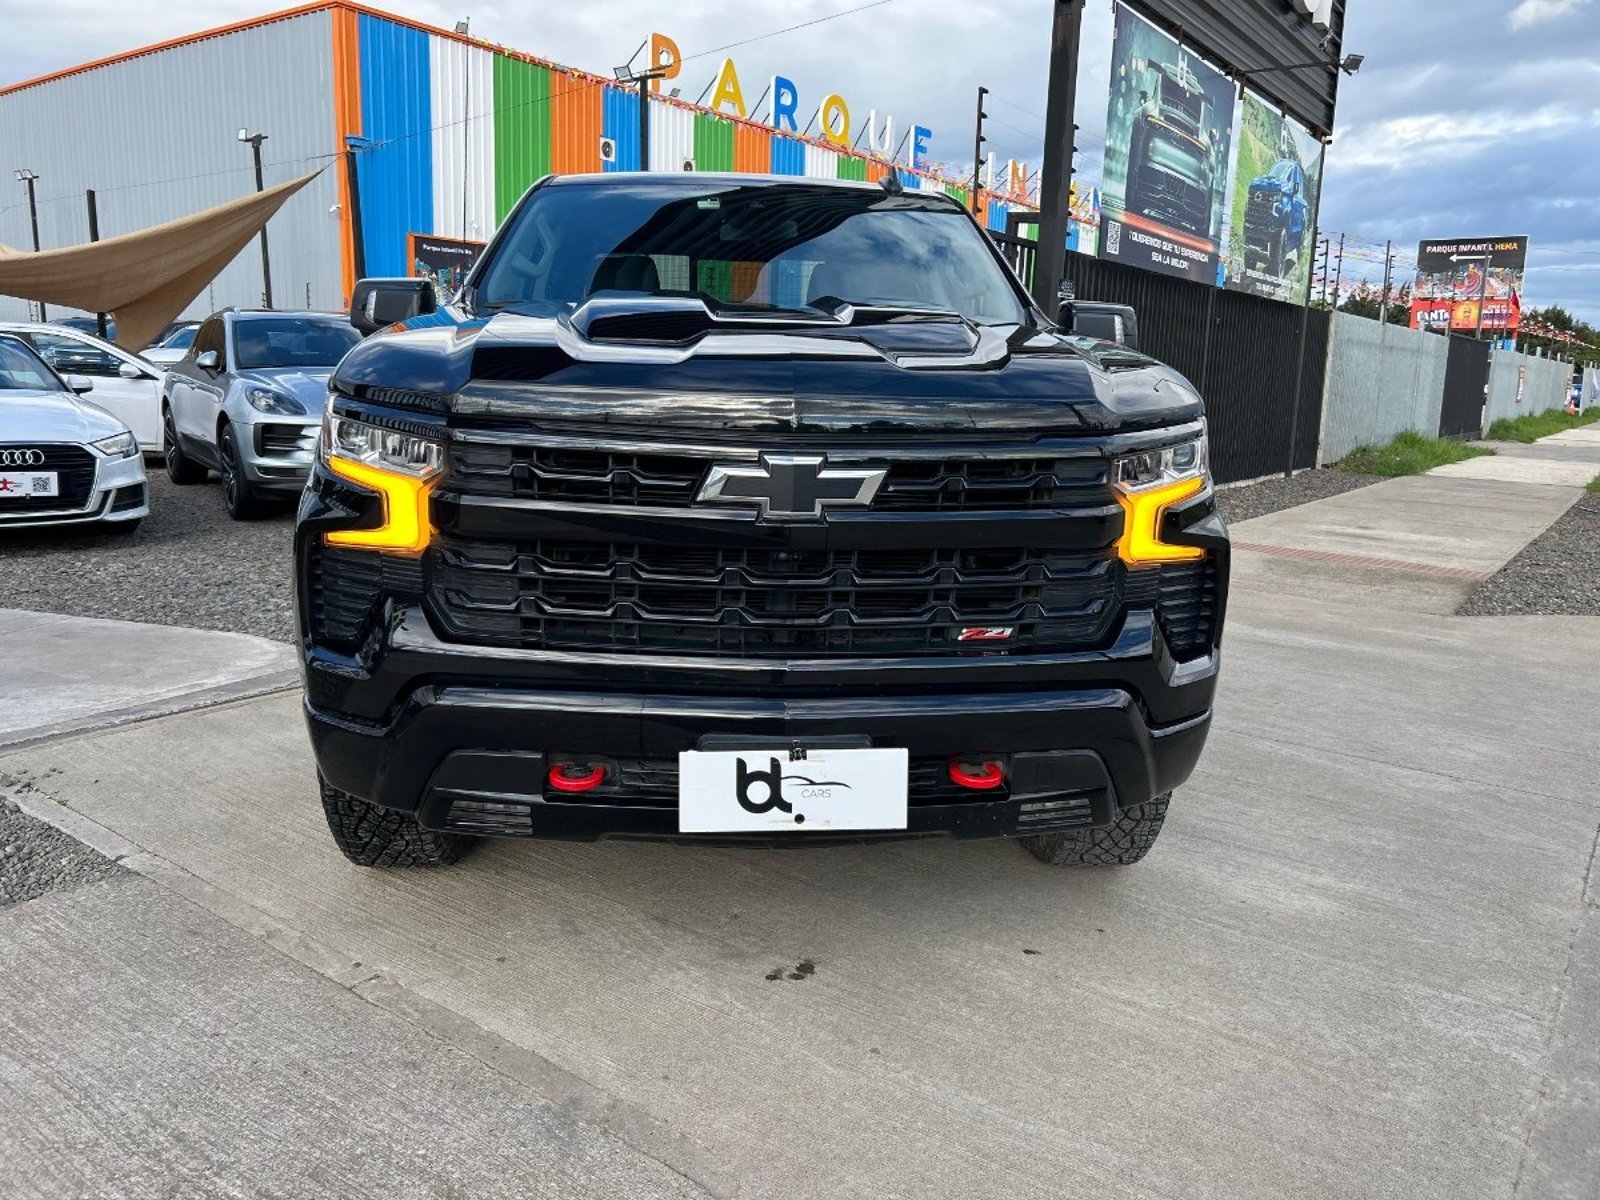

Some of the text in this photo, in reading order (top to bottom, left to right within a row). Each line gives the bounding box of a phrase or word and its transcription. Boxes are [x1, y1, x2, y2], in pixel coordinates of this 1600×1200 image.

[648, 32, 932, 169] PARQUE
[1426, 244, 1457, 254] PARQUE
[1458, 243, 1493, 253] INFANTL
[801, 788, 832, 799] CARS
